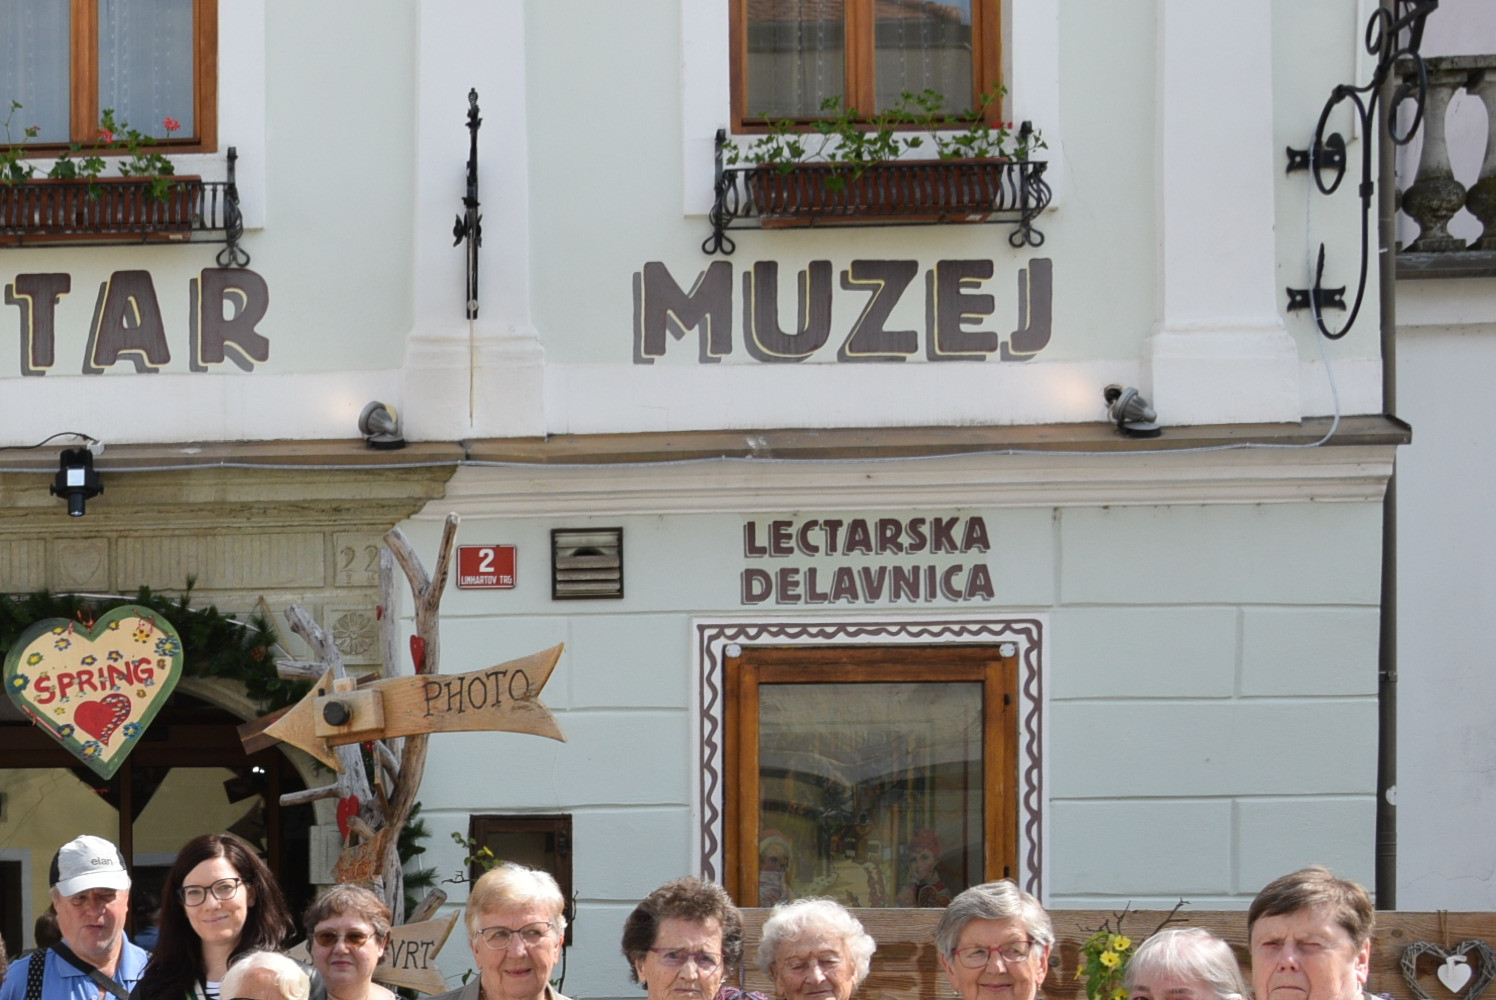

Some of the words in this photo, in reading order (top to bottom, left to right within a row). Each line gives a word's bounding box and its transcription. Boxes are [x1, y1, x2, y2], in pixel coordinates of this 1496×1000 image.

[632, 258, 1053, 365] MUZEJ
[743, 514, 991, 559] LECTARSKA
[460, 575, 497, 585] LINHARTOV
[499, 575, 513, 585] TRG
[478, 548, 495, 573] 2
[740, 562, 995, 605] DELAVNICA
[33, 657, 155, 705] SPRING
[421, 668, 531, 719] PHOTO
[90, 856, 114, 866] elan
[388, 939, 435, 970] VRT
